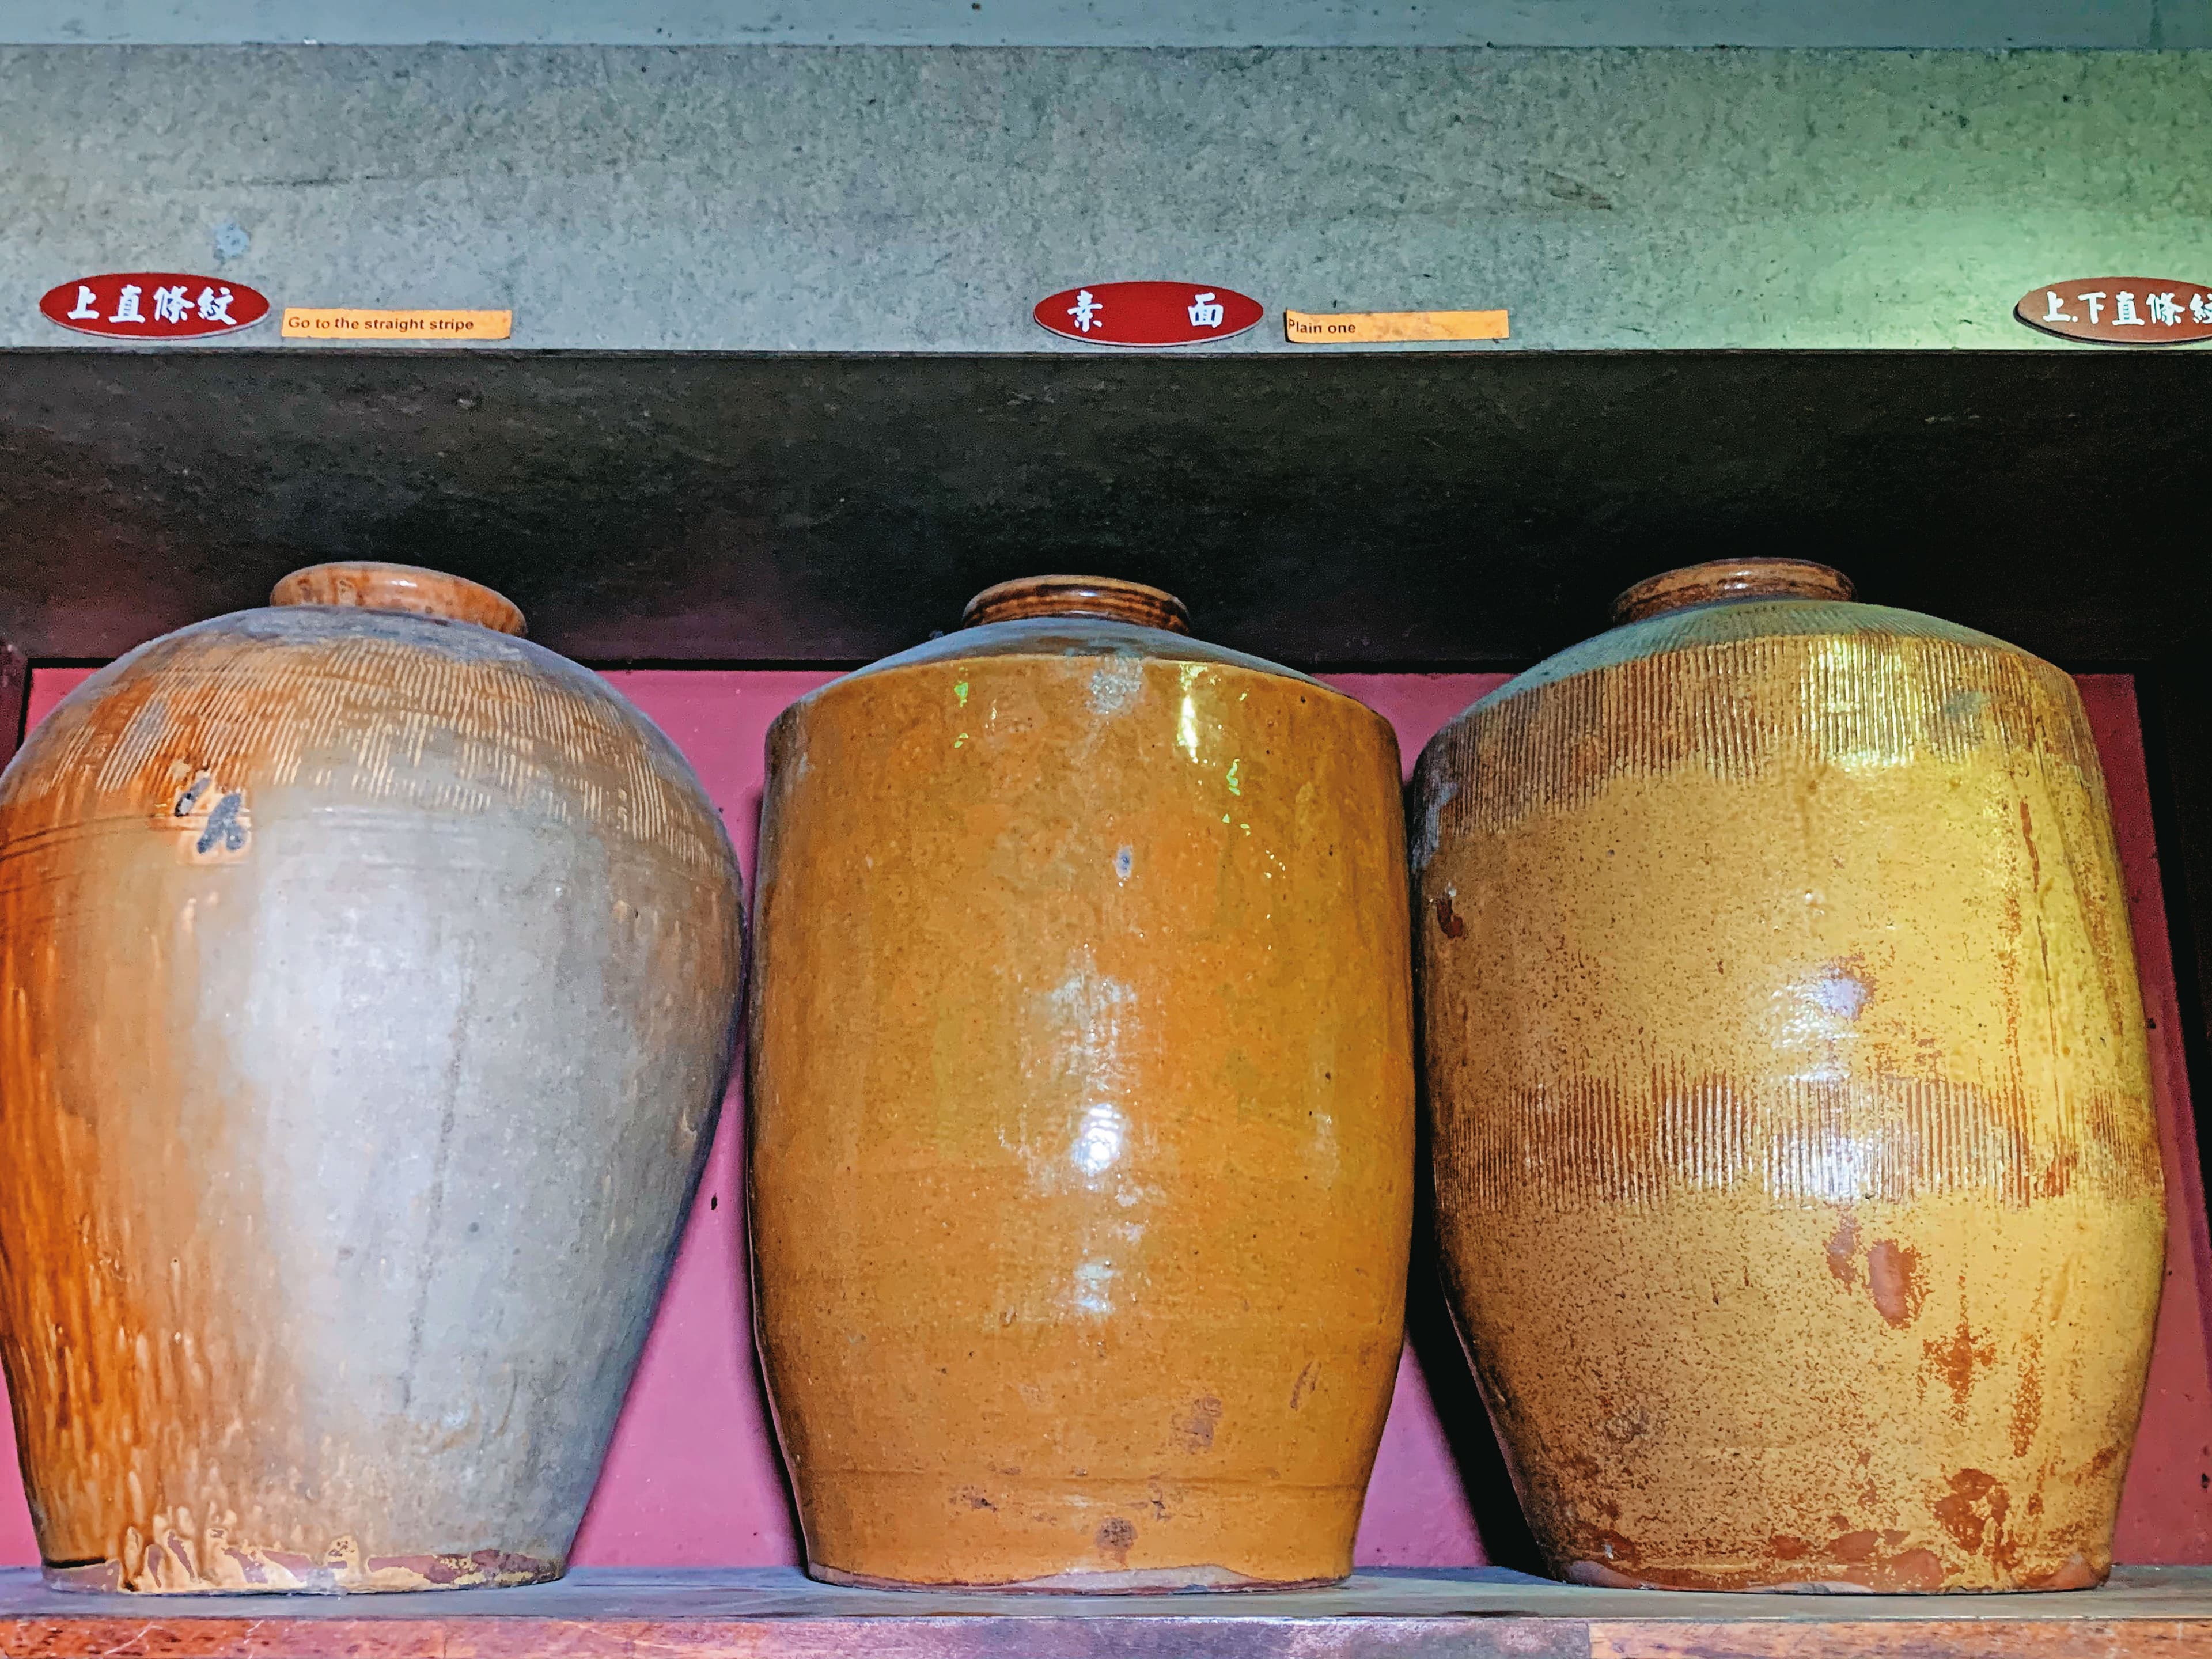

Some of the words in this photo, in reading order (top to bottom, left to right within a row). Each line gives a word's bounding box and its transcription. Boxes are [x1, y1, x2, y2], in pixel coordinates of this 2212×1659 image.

[67, 284, 237, 325] 上直條紋
[287, 316, 310, 329] Go
[316, 319, 331, 329] to
[335, 317, 359, 329] the
[364, 317, 425, 332] straight
[429, 318, 474, 332] stripe
[1288, 317, 1323, 334] Plain
[1327, 324, 1356, 334] one
